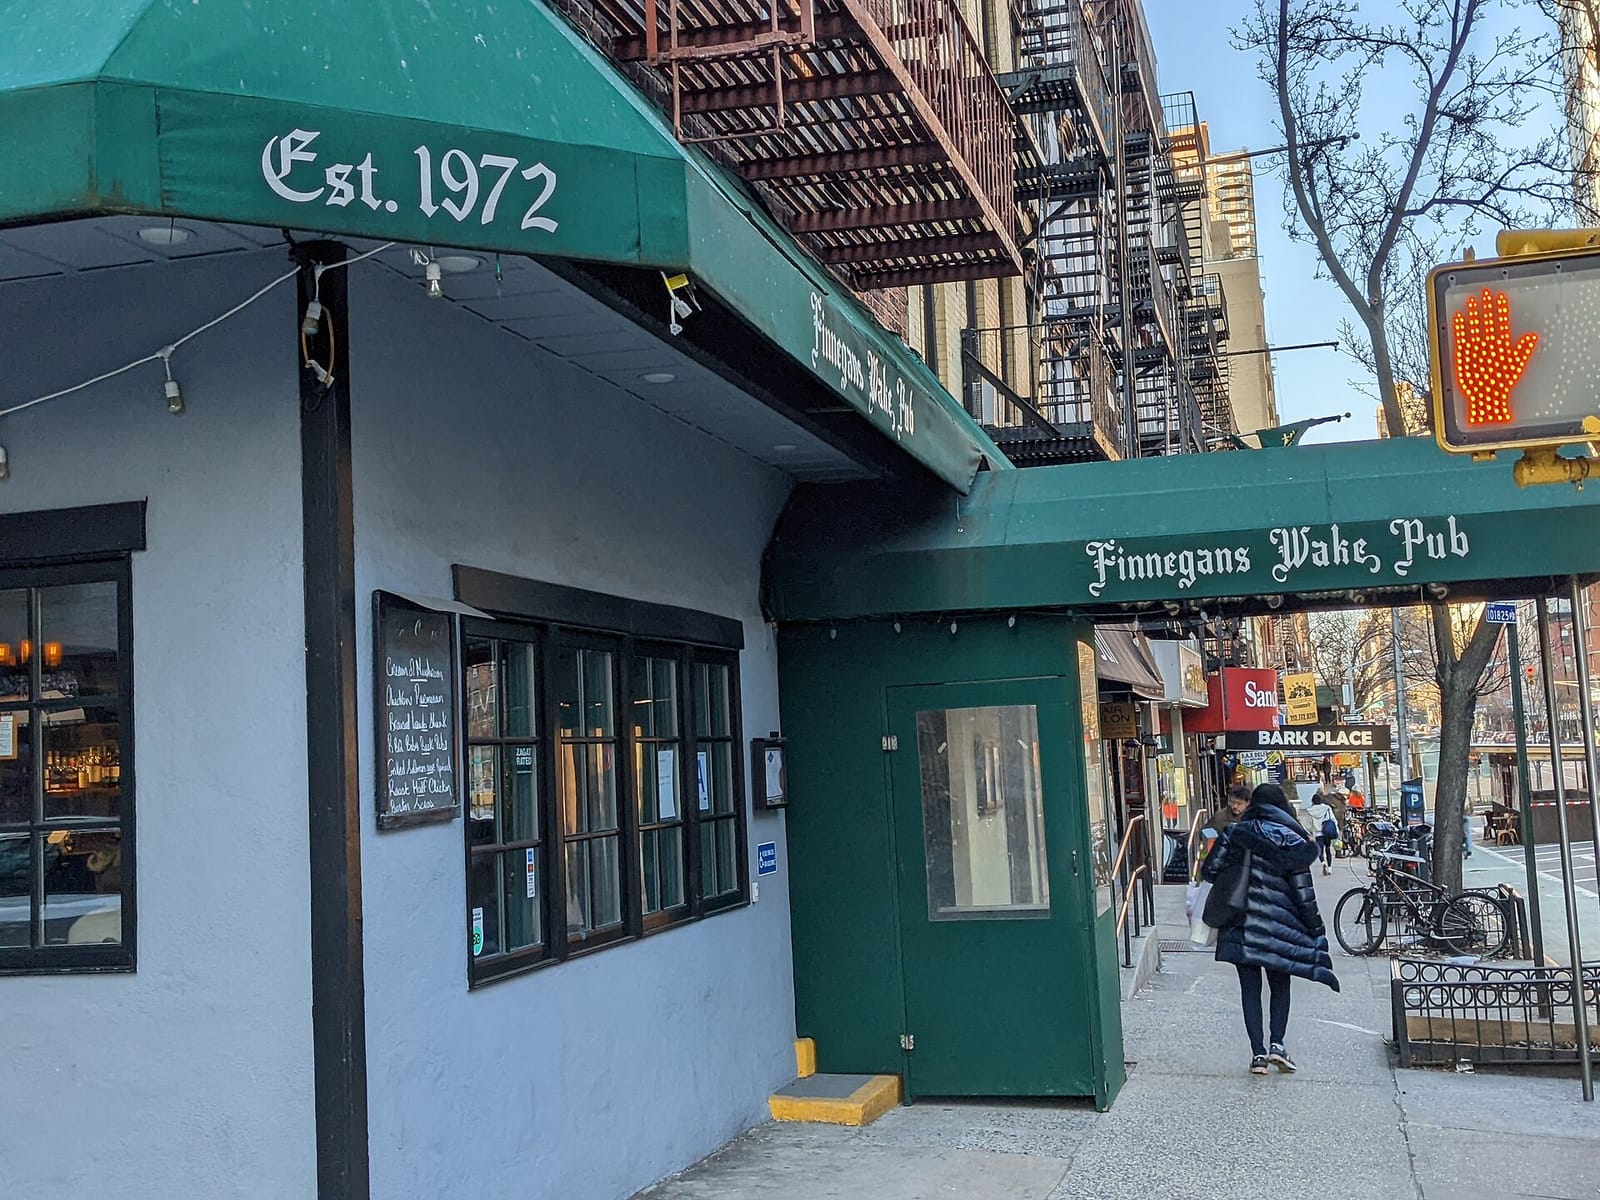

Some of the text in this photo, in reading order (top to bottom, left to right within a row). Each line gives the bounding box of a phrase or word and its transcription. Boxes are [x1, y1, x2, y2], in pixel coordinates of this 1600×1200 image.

[261, 128, 559, 234] Est. 1972
[810, 291, 915, 441] Finnegans Wake Pub
[1086, 514, 1470, 597] Finnegans Wake Pub
[1258, 730, 1309, 746] BARK
[1313, 730, 1373, 746] PLACE
[516, 747, 532, 756] ZAGAT
[516, 757, 532, 766] RATED
[388, 779, 410, 797] Roast
[412, 779, 428, 795] Half
